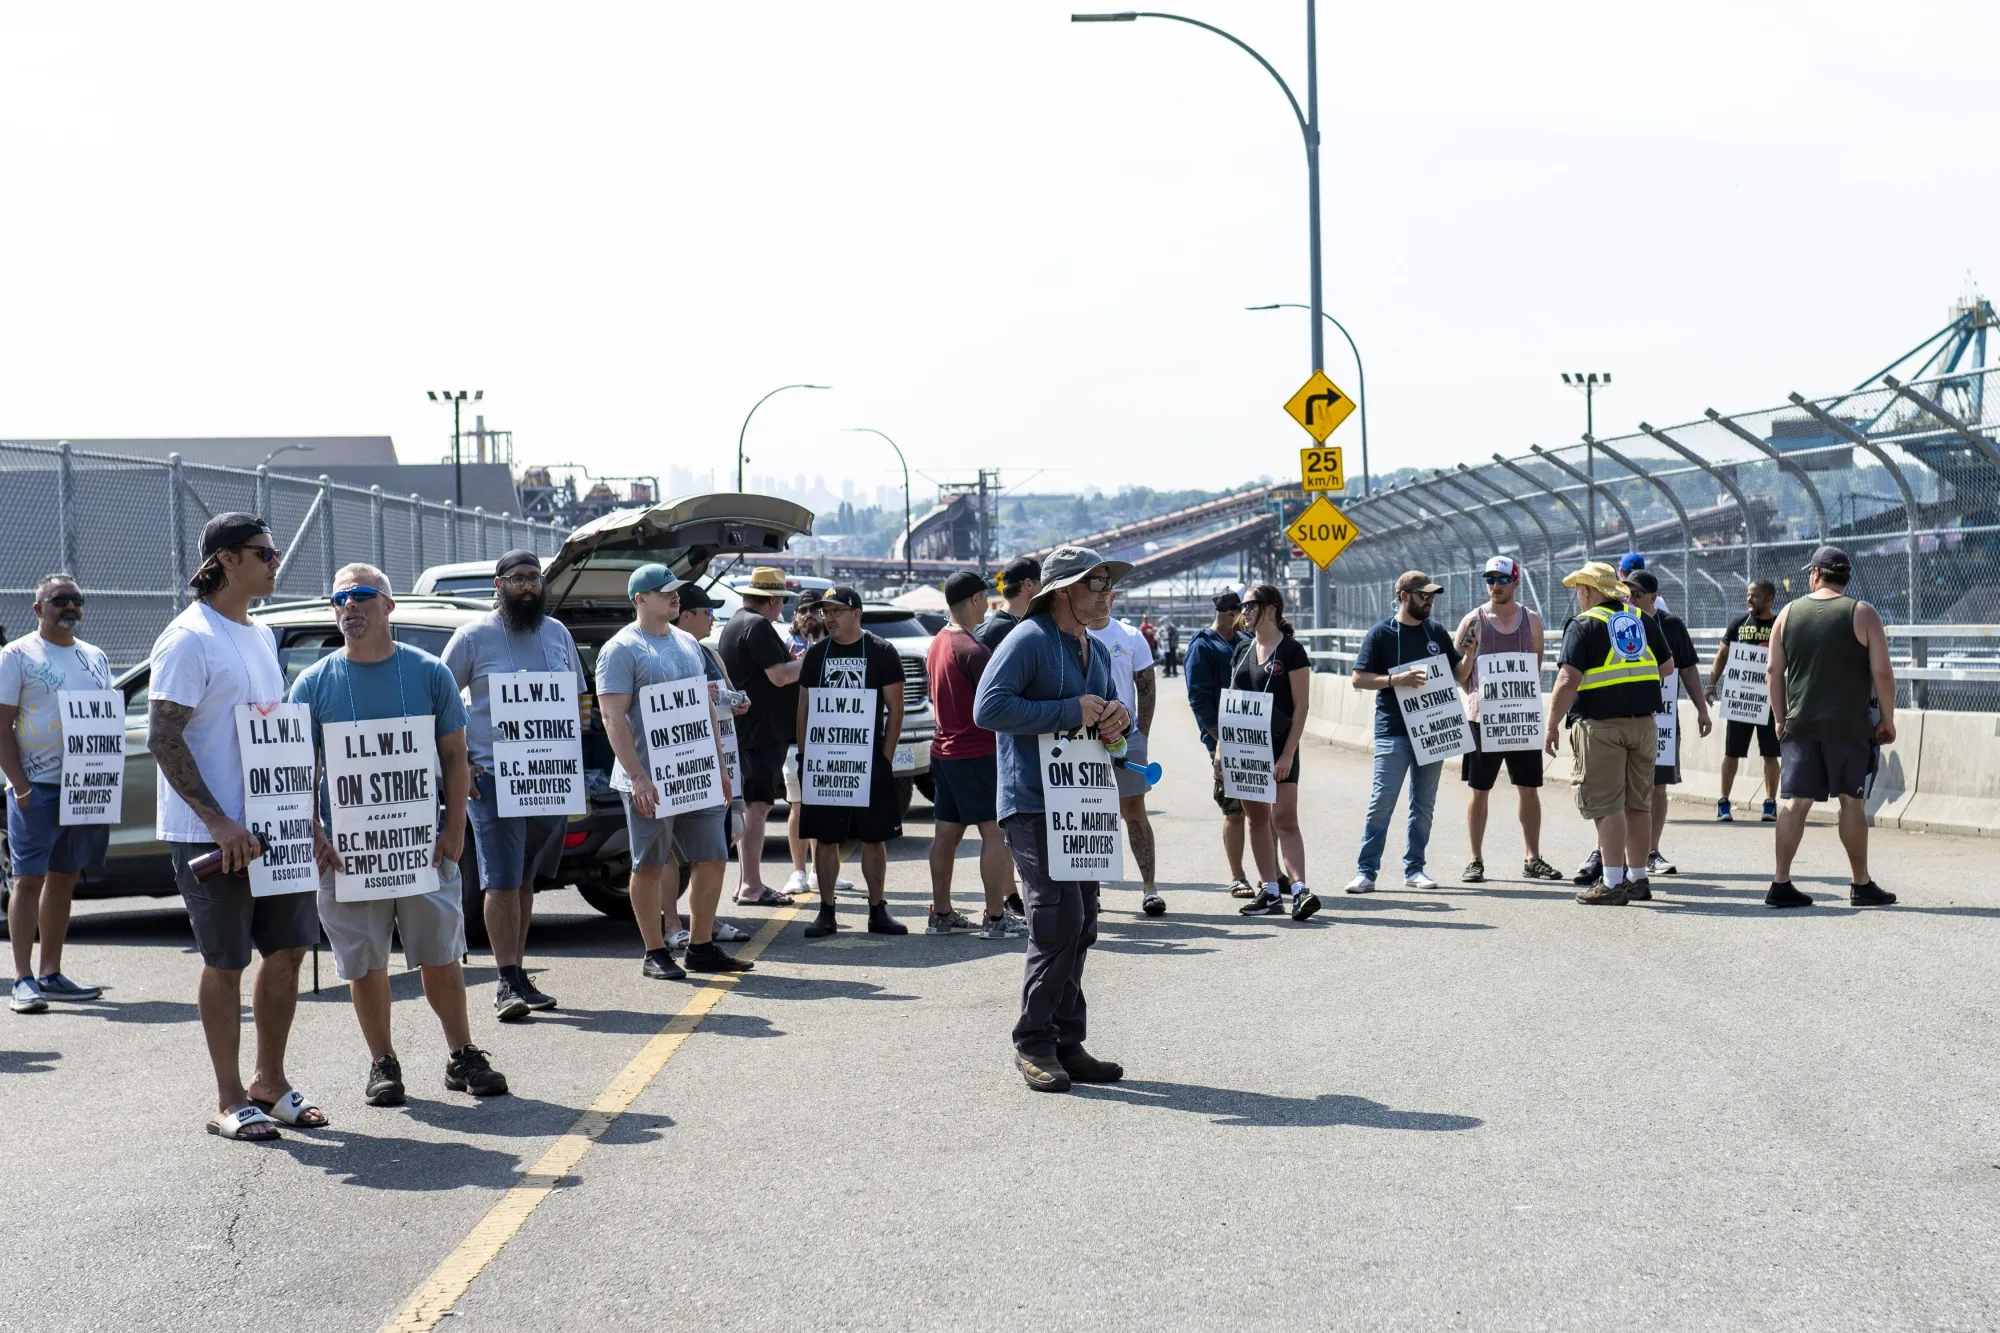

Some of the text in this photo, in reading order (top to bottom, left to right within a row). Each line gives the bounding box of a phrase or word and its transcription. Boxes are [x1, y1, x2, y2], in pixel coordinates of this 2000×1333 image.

[1308, 452, 1337, 472] 25
[1308, 475, 1339, 487] km/h
[1298, 524, 1347, 541] SLOW
[1735, 649, 1768, 664] I.L.W.U.
[1489, 660, 1528, 674] I.L.W.U.
[1729, 668, 1767, 684] ON STRIK
[502, 684, 565, 703] I.L.W.U.
[1484, 681, 1536, 699] ON STRIKE
[1725, 689, 1768, 703] B.C. MARITIME
[650, 688, 700, 713] I.L.W.U.
[817, 697, 864, 714] I.L.W.U.
[1226, 698, 1263, 716] I.L.W.U.
[1403, 687, 1457, 713] ON STRIKE
[1728, 700, 1762, 713] EMPLOYERS
[69, 702, 116, 718] I.L.W.U.
[1483, 712, 1540, 725] B.C. MARITIME
[250, 719, 304, 744] I.L.W.U.
[524, 720, 575, 740] STRIKE
[651, 719, 710, 747] ON STRIKE
[1411, 714, 1464, 738] B.C. MARITIME
[1487, 725, 1538, 737] EMPLOYERS
[68, 735, 122, 753] ON STRIKE
[810, 727, 869, 744] ON STRIKE
[1222, 726, 1268, 745] ON STRIKE
[1421, 729, 1463, 749] EMPLOYERS
[345, 731, 417, 758] I.L.W.U.
[1429, 742, 1461, 755] ASSOCIATION
[500, 759, 578, 777] B.C. MARITIME
[655, 764, 674, 781] B.C.
[677, 756, 715, 777] MARITIME
[807, 760, 867, 774] B.C. MARITIME
[1224, 757, 1271, 773] B.C. MARITIME
[65, 772, 120, 787] B.C. MARITIME
[250, 766, 312, 794] ON STRIKE
[813, 775, 859, 789] EMPLOYERS
[1049, 762, 1074, 786] ON
[1231, 771, 1268, 786] EMPLOYERS
[337, 768, 428, 806] ON STRIKE
[511, 778, 571, 795] EMPLOYERS
[664, 774, 712, 796] EMPLOYERS
[817, 789, 853, 798] ASSOCIATION
[1237, 784, 1265, 794] ASSOCIATION
[69, 789, 112, 805] EMPLOYERS
[520, 796, 566, 806] ASSOCIATION
[671, 791, 708, 806] ASSOCIATION
[72, 806, 105, 815] ASSOCIATION
[367, 812, 407, 821] AGAINST
[1053, 812, 1118, 832] B.C. MARITIME
[338, 825, 432, 853] B.C. MARITIME
[1063, 835, 1113, 854] EMPLOYERS
[263, 843, 312, 867] EMPLOYERS
[344, 848, 428, 876] EMPLOYERS
[1071, 857, 1108, 868] ASSOCIATION
[272, 867, 311, 881] ASSOCIATION
[364, 873, 416, 889] ASSOCIATION
